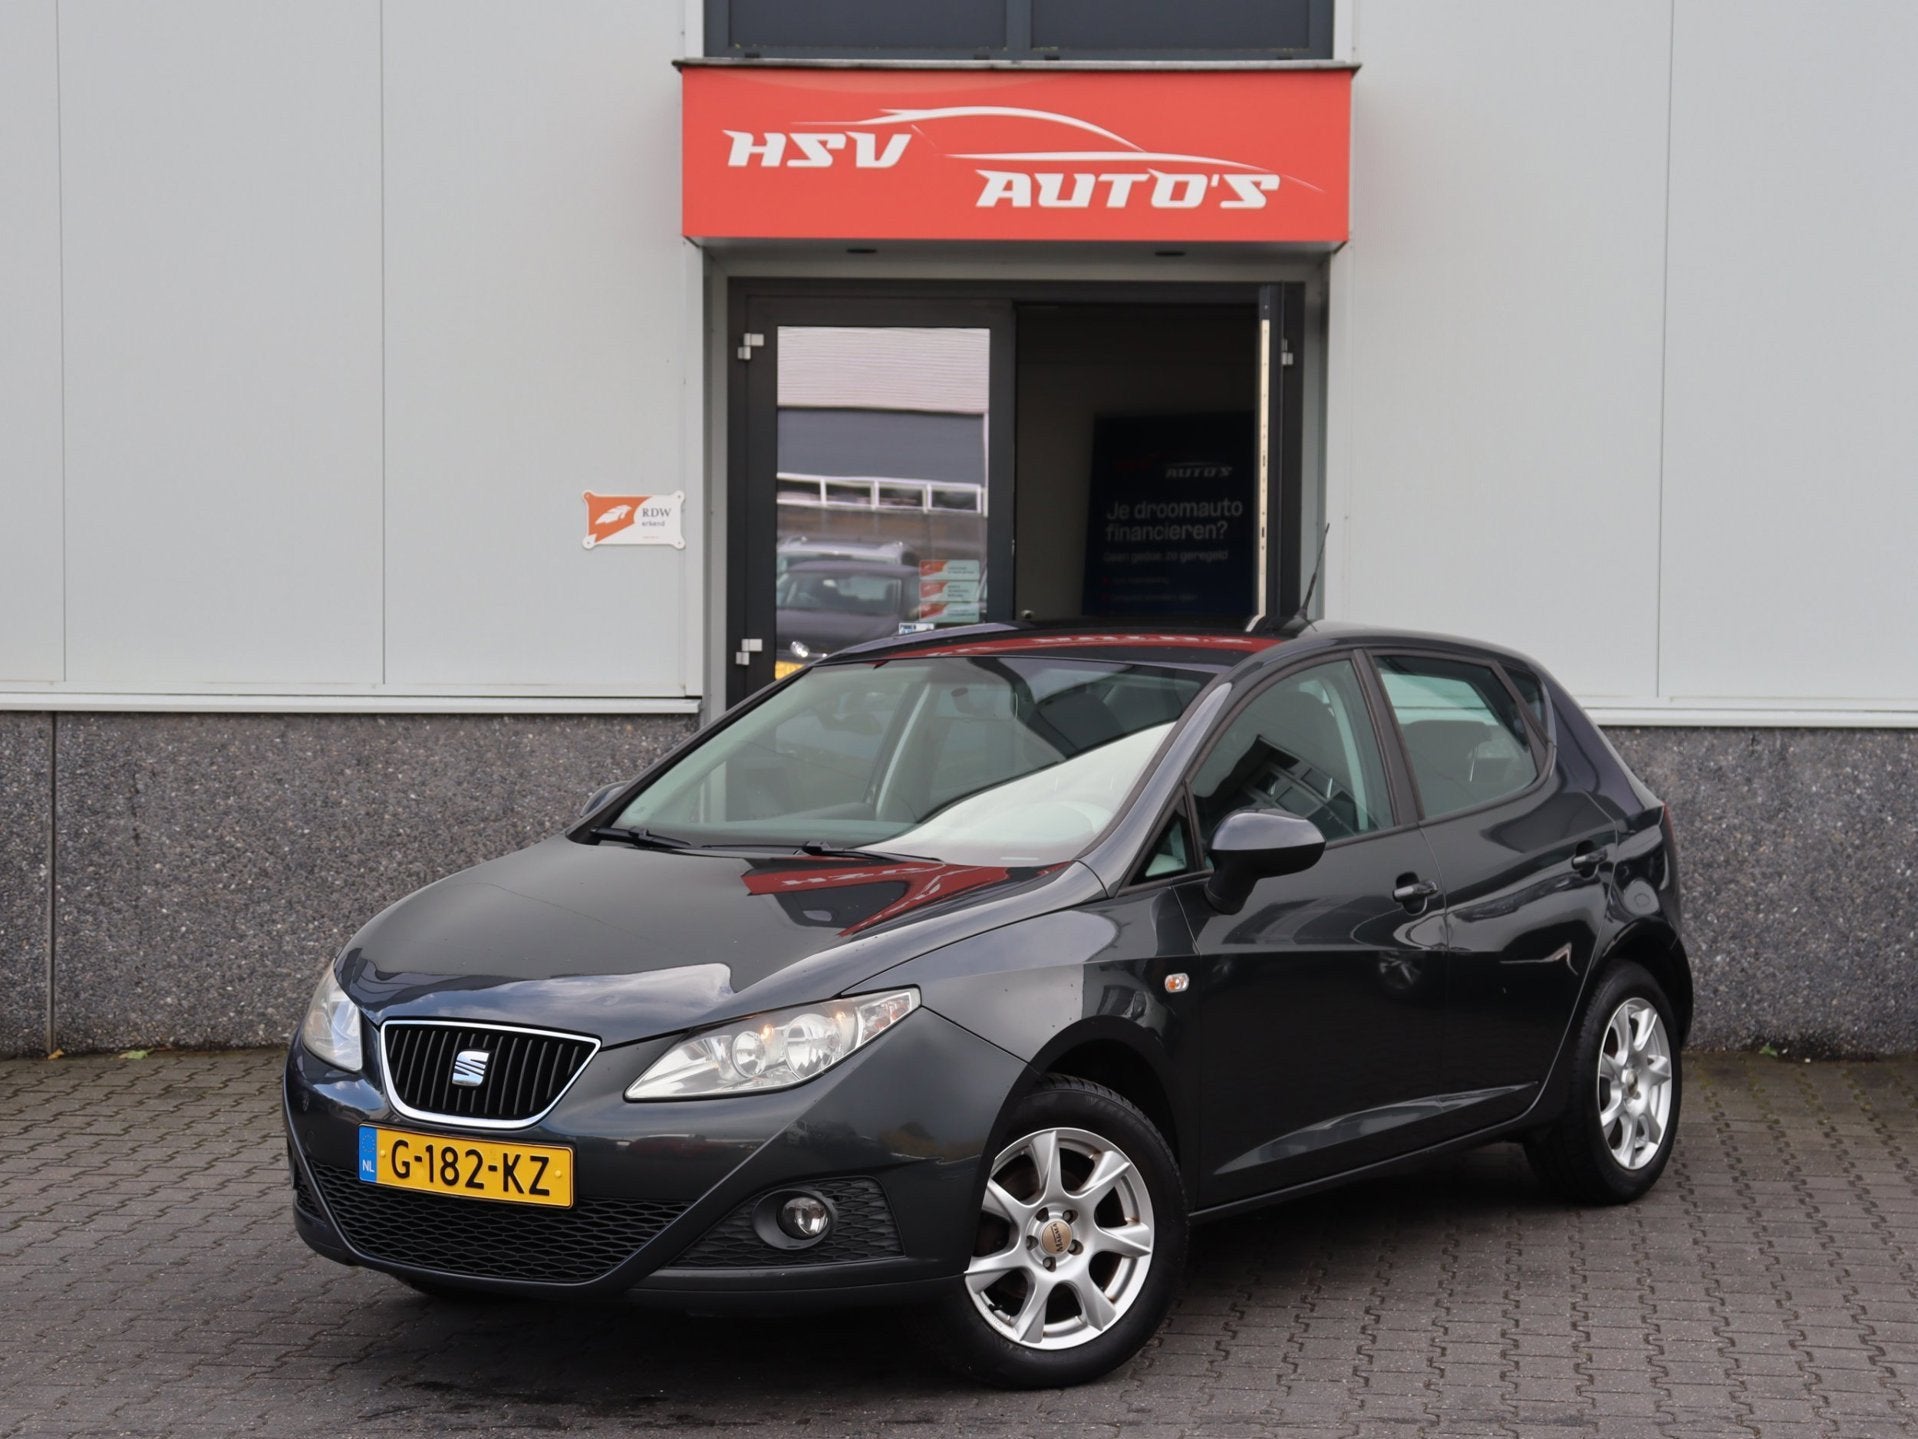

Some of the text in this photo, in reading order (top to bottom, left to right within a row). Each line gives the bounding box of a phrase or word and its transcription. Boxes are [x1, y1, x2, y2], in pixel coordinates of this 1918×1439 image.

[722, 129, 912, 168] HSV
[975, 168, 1280, 209] AUTO'S
[642, 507, 672, 518] RDW
[1106, 498, 1244, 520] Je droomauto
[1105, 520, 1229, 542] financieren?
[362, 1159, 375, 1173] NL
[391, 1139, 550, 1196] G-182-KZ
